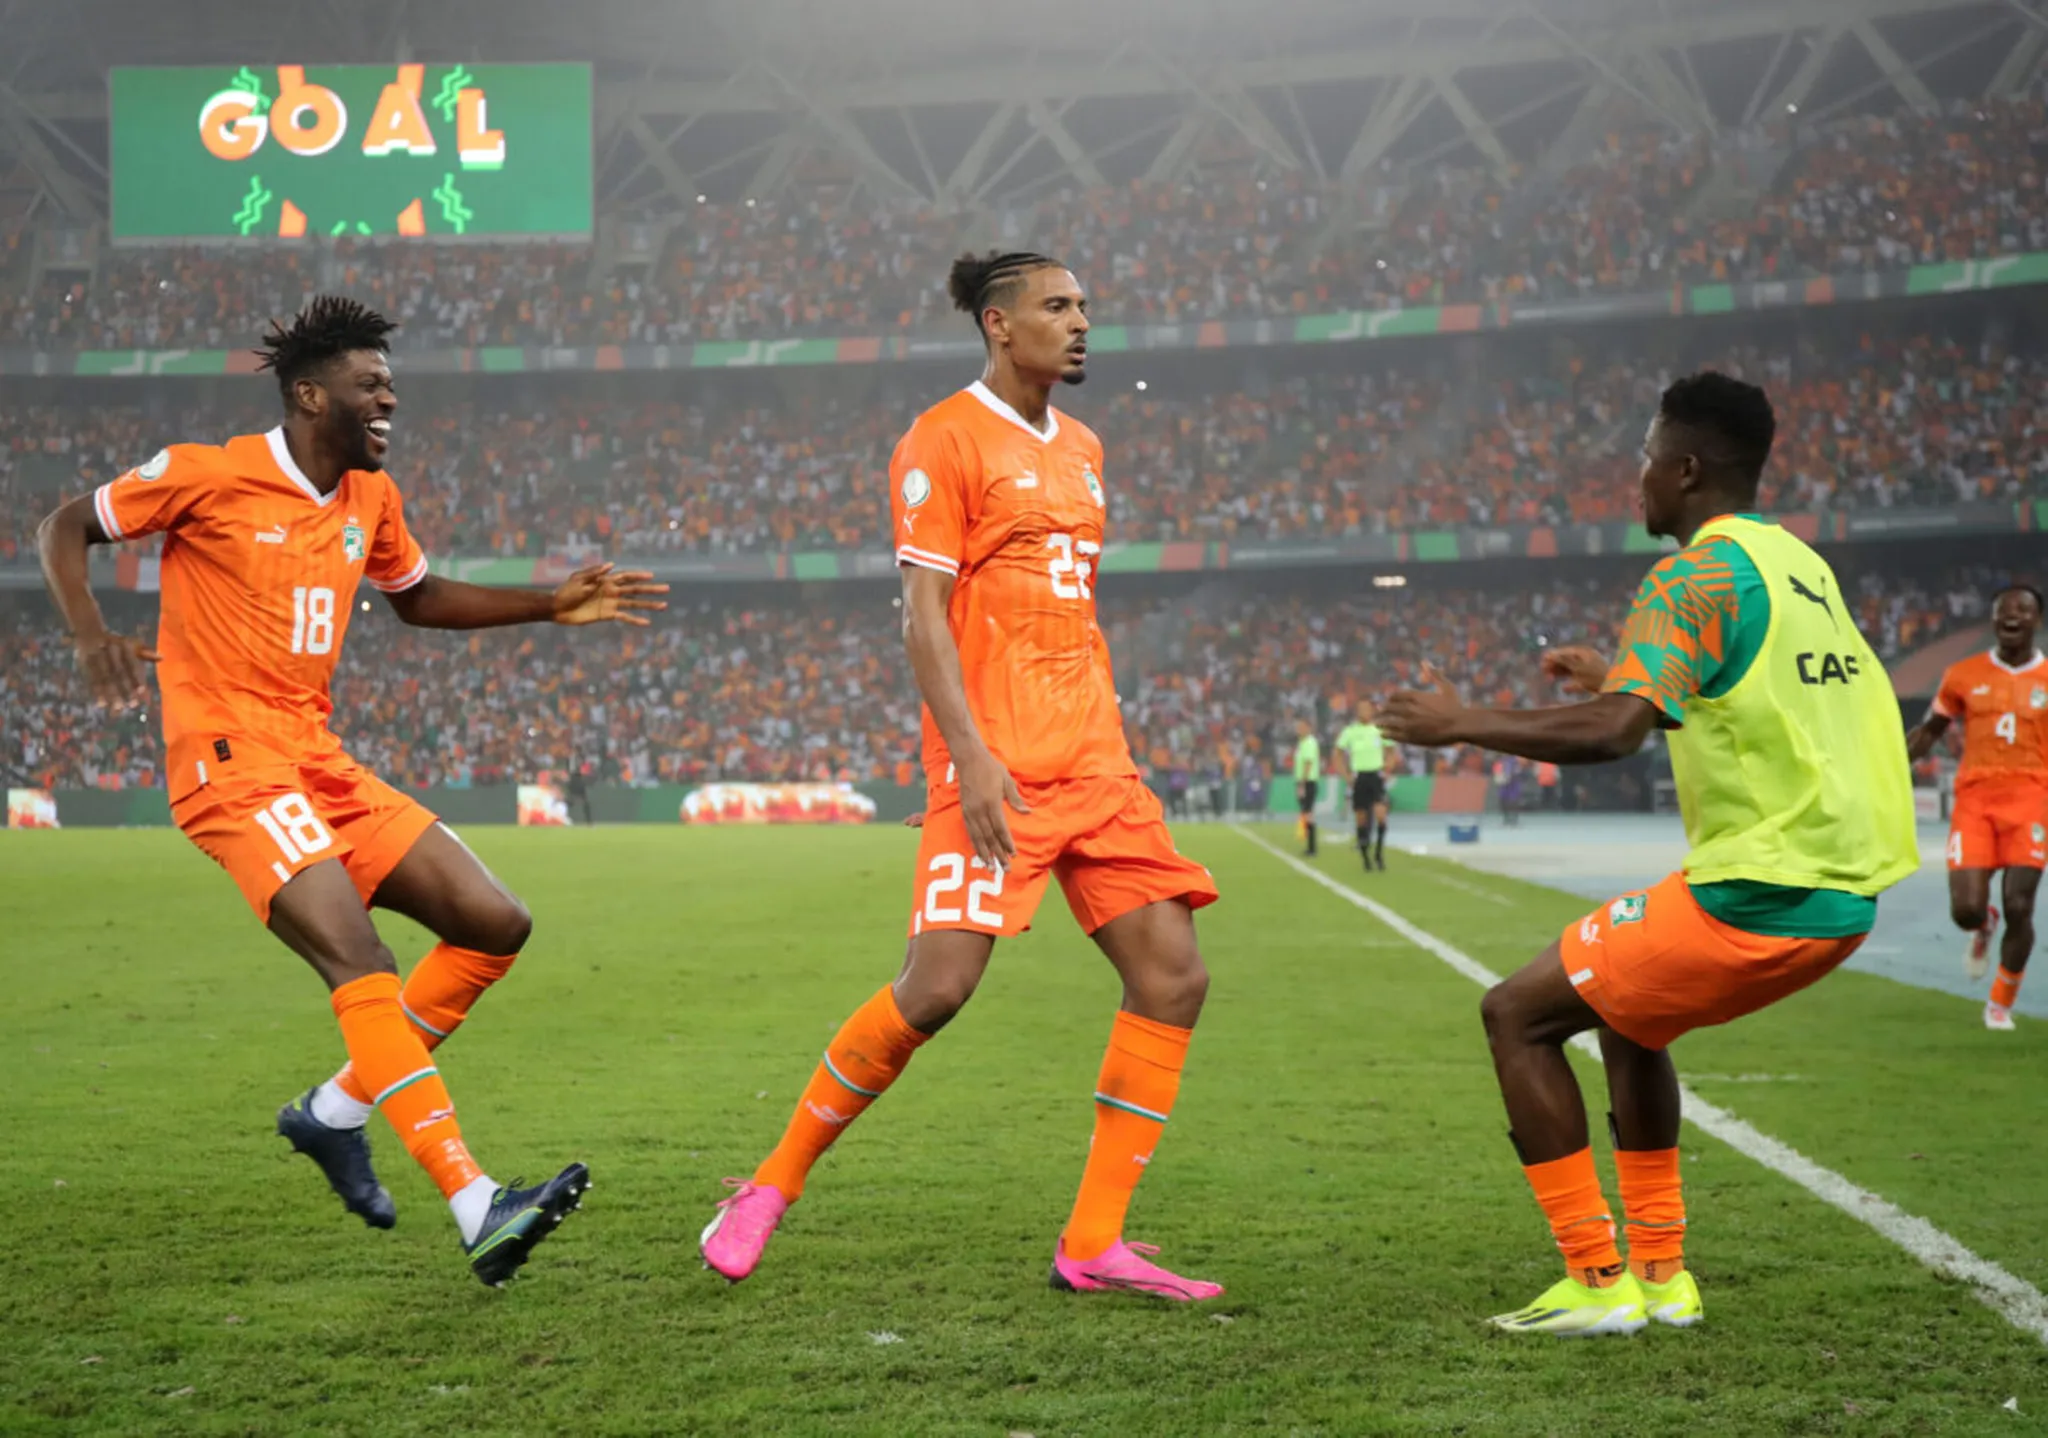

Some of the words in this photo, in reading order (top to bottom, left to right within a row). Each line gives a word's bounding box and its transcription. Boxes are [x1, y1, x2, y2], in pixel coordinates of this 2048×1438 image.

[200, 83, 505, 170] GOAL
[291, 587, 335, 654] 18
[1796, 652, 1860, 685] CAF
[1995, 712, 2016, 744] 4
[254, 792, 332, 864] 18
[1948, 831, 1962, 866] 4
[925, 852, 1005, 928] 22
